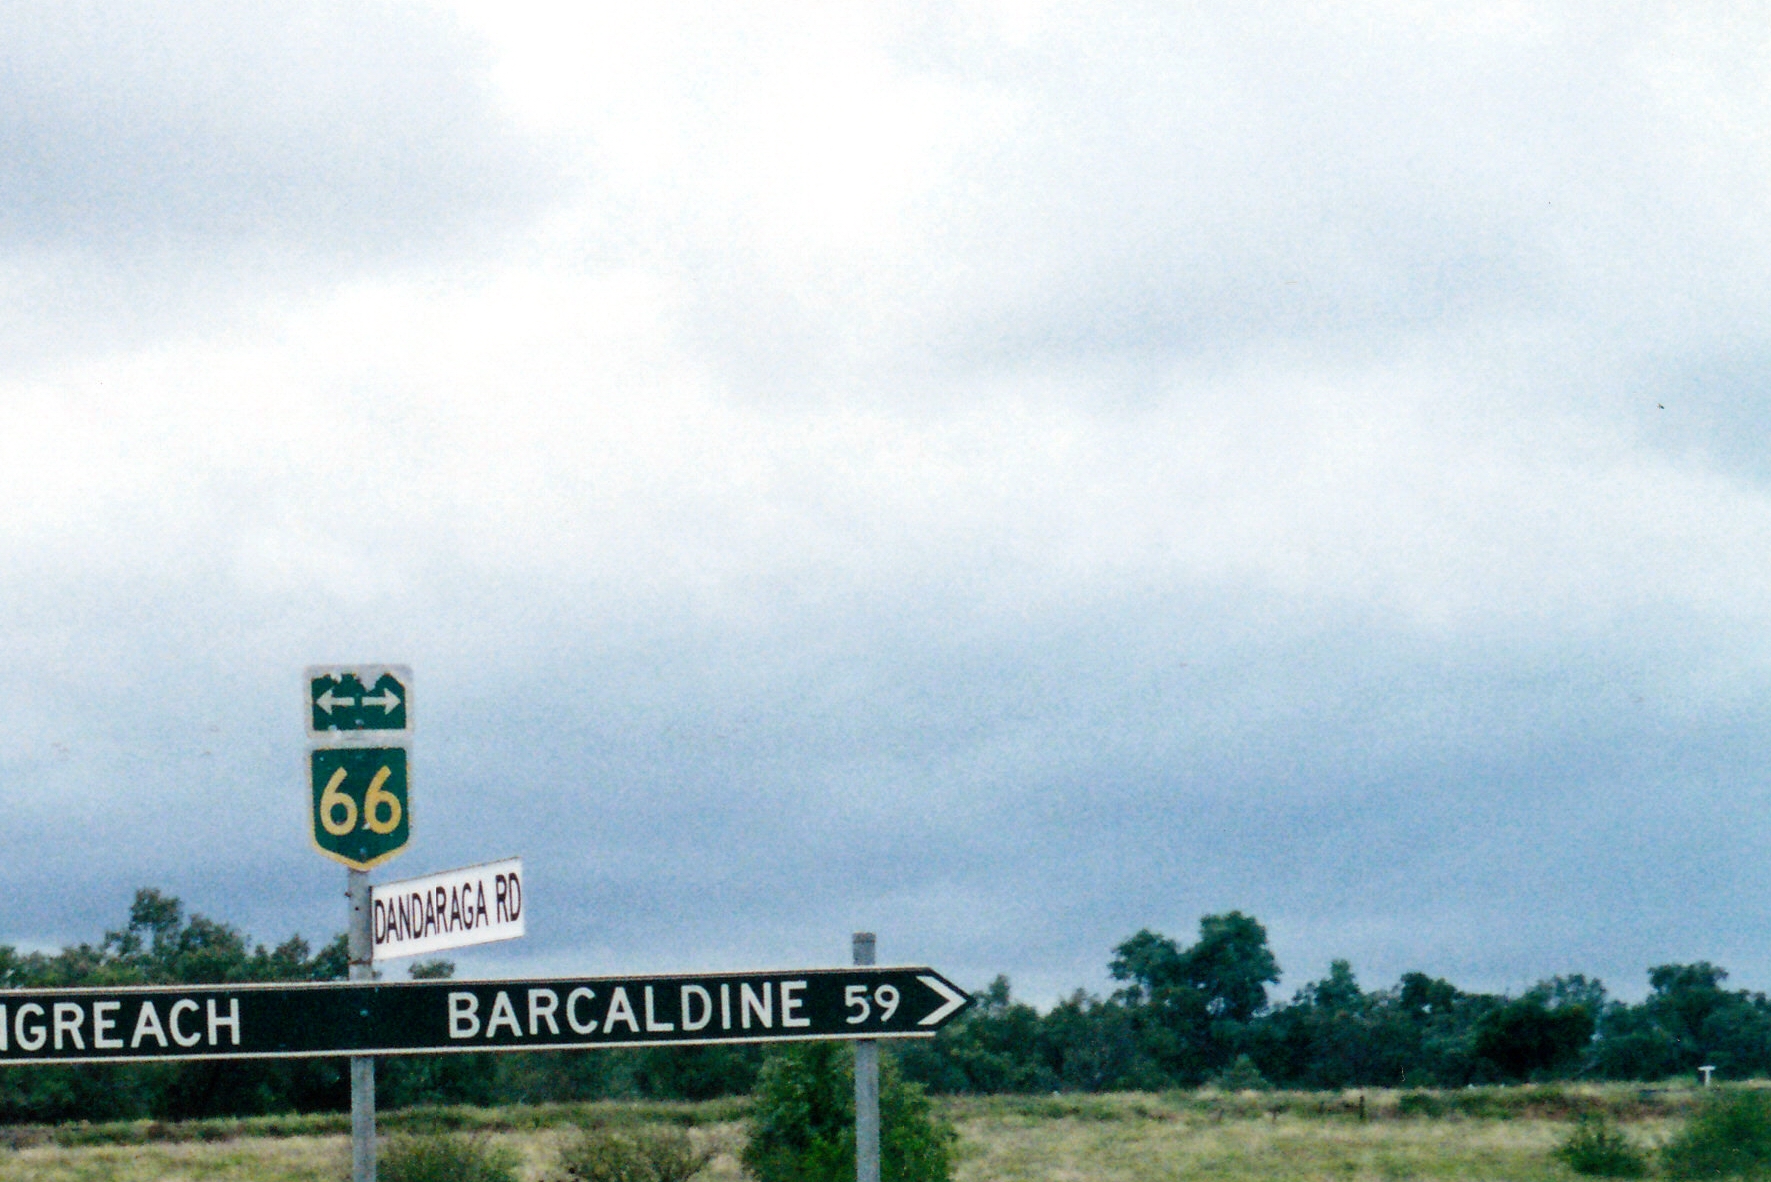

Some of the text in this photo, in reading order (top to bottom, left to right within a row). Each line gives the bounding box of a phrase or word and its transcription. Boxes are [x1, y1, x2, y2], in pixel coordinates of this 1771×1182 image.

[319, 765, 402, 836] 66
[374, 872, 522, 945] DANDARAGA RD
[447, 980, 901, 1039] BARCALDINE 59
